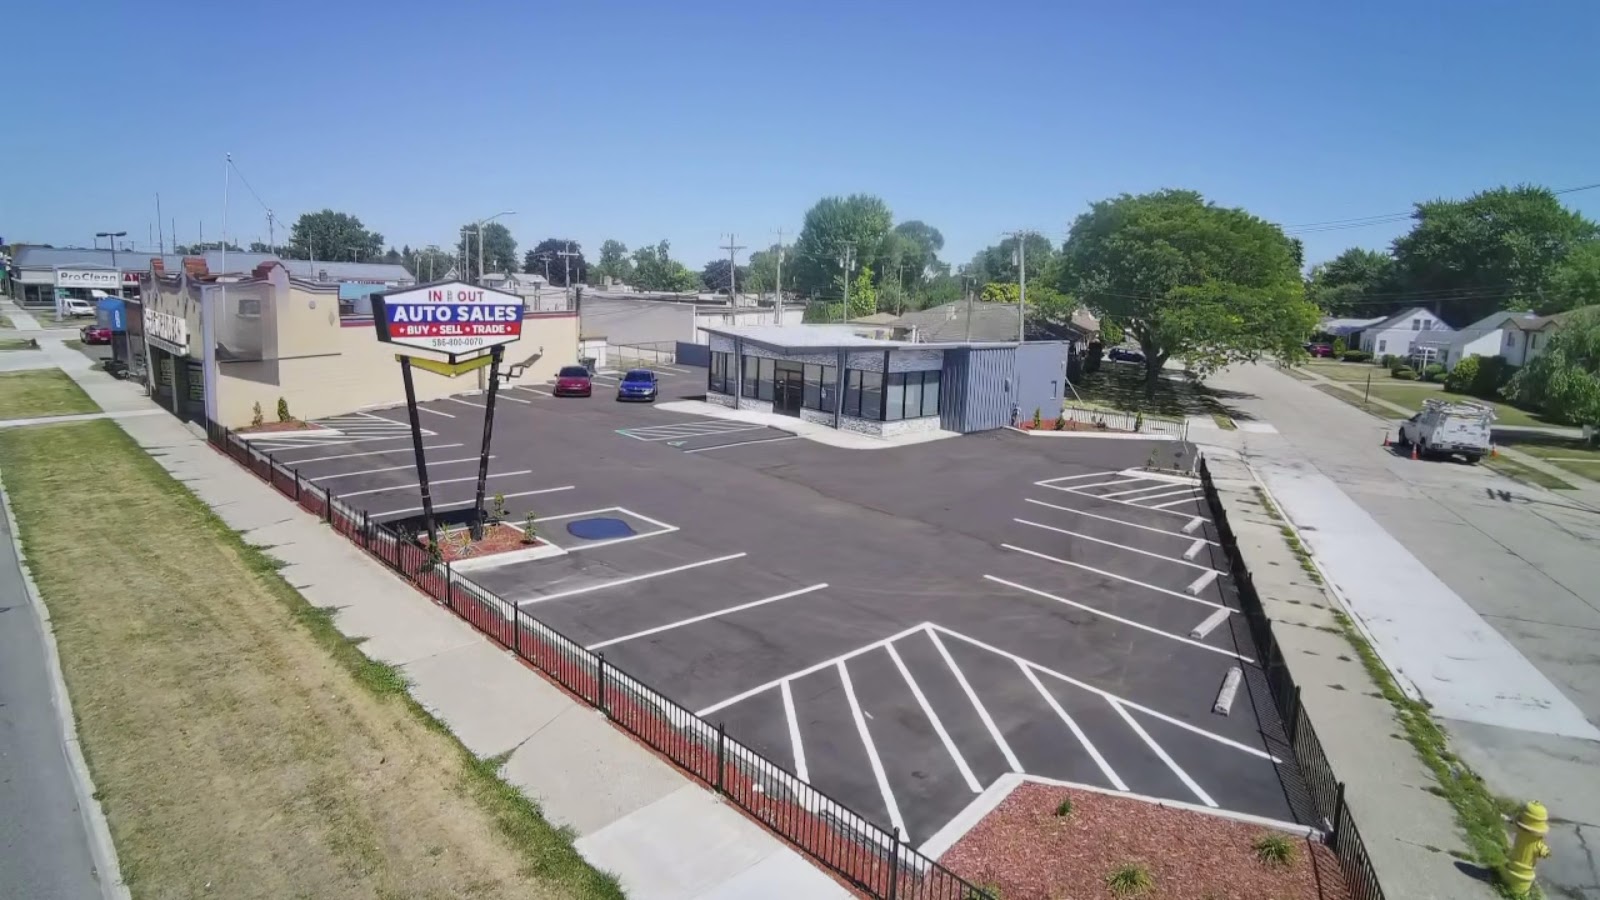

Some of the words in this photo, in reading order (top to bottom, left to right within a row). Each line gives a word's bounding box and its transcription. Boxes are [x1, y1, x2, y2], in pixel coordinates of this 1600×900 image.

[61, 272, 116, 281] ProClean
[428, 290, 442, 301] IN
[457, 291, 485, 302] OUT
[394, 306, 451, 322] AUTO
[457, 306, 517, 322] SALES
[406, 325, 430, 335] BUY
[439, 324, 463, 335] SELL
[472, 324, 506, 334] TRADE
